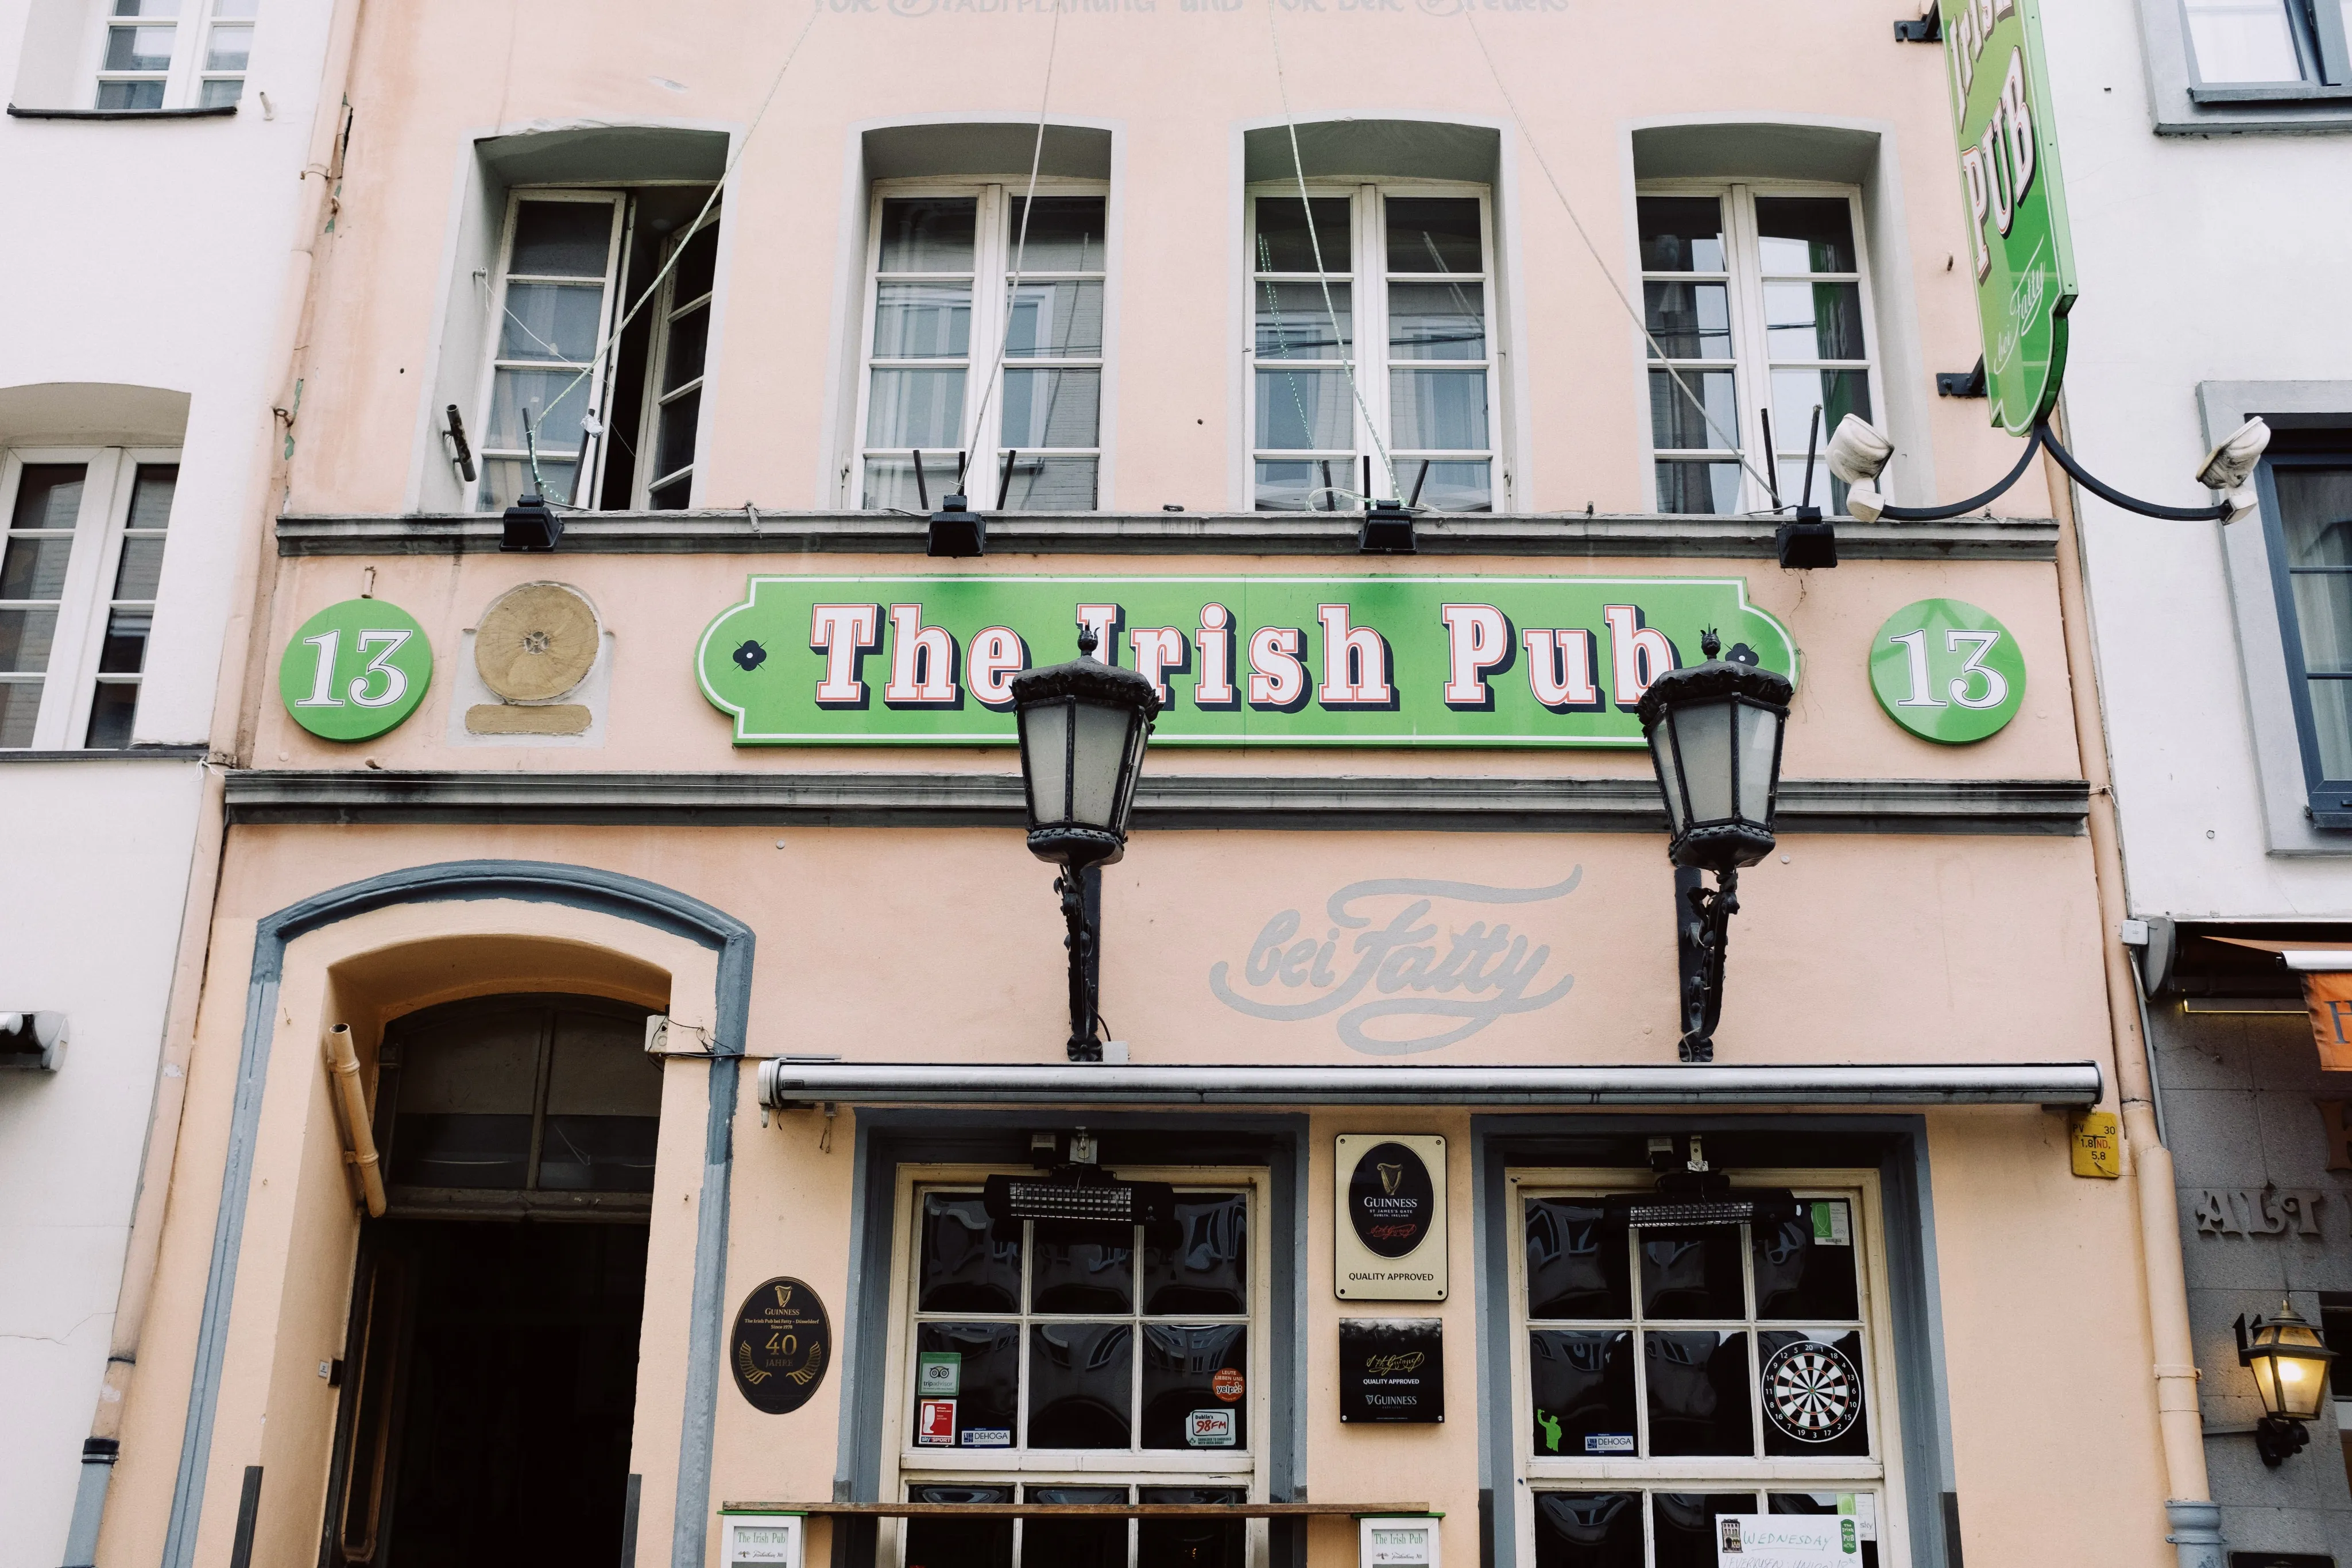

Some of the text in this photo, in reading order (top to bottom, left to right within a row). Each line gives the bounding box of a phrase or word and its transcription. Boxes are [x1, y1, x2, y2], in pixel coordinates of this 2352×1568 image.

[1962, 45, 2036, 287] PUB
[1994, 233, 2045, 374] bei Fatty
[808, 601, 1682, 714] The Irish Pub
[295, 629, 413, 708] 13
[1889, 629, 2009, 710] 13
[1209, 864, 1584, 1056] bei Fatty
[2072, 1124, 2115, 1135] PV 30
[2091, 1151, 2106, 1160] 5,8
[1364, 1197, 1417, 1207] GUINNESS
[2195, 1190, 2322, 1237] ALT
[765, 1332, 797, 1355] 40
[766, 1359, 793, 1368] JAHRE
[1216, 1384, 1234, 1395] yelp
[1375, 1395, 1417, 1405] GUINNESS
[738, 1532, 785, 1543] The Irish Pub
[1374, 1533, 1422, 1544] The Irish Pub
[1743, 1531, 1833, 1550] WEDNESDAY
